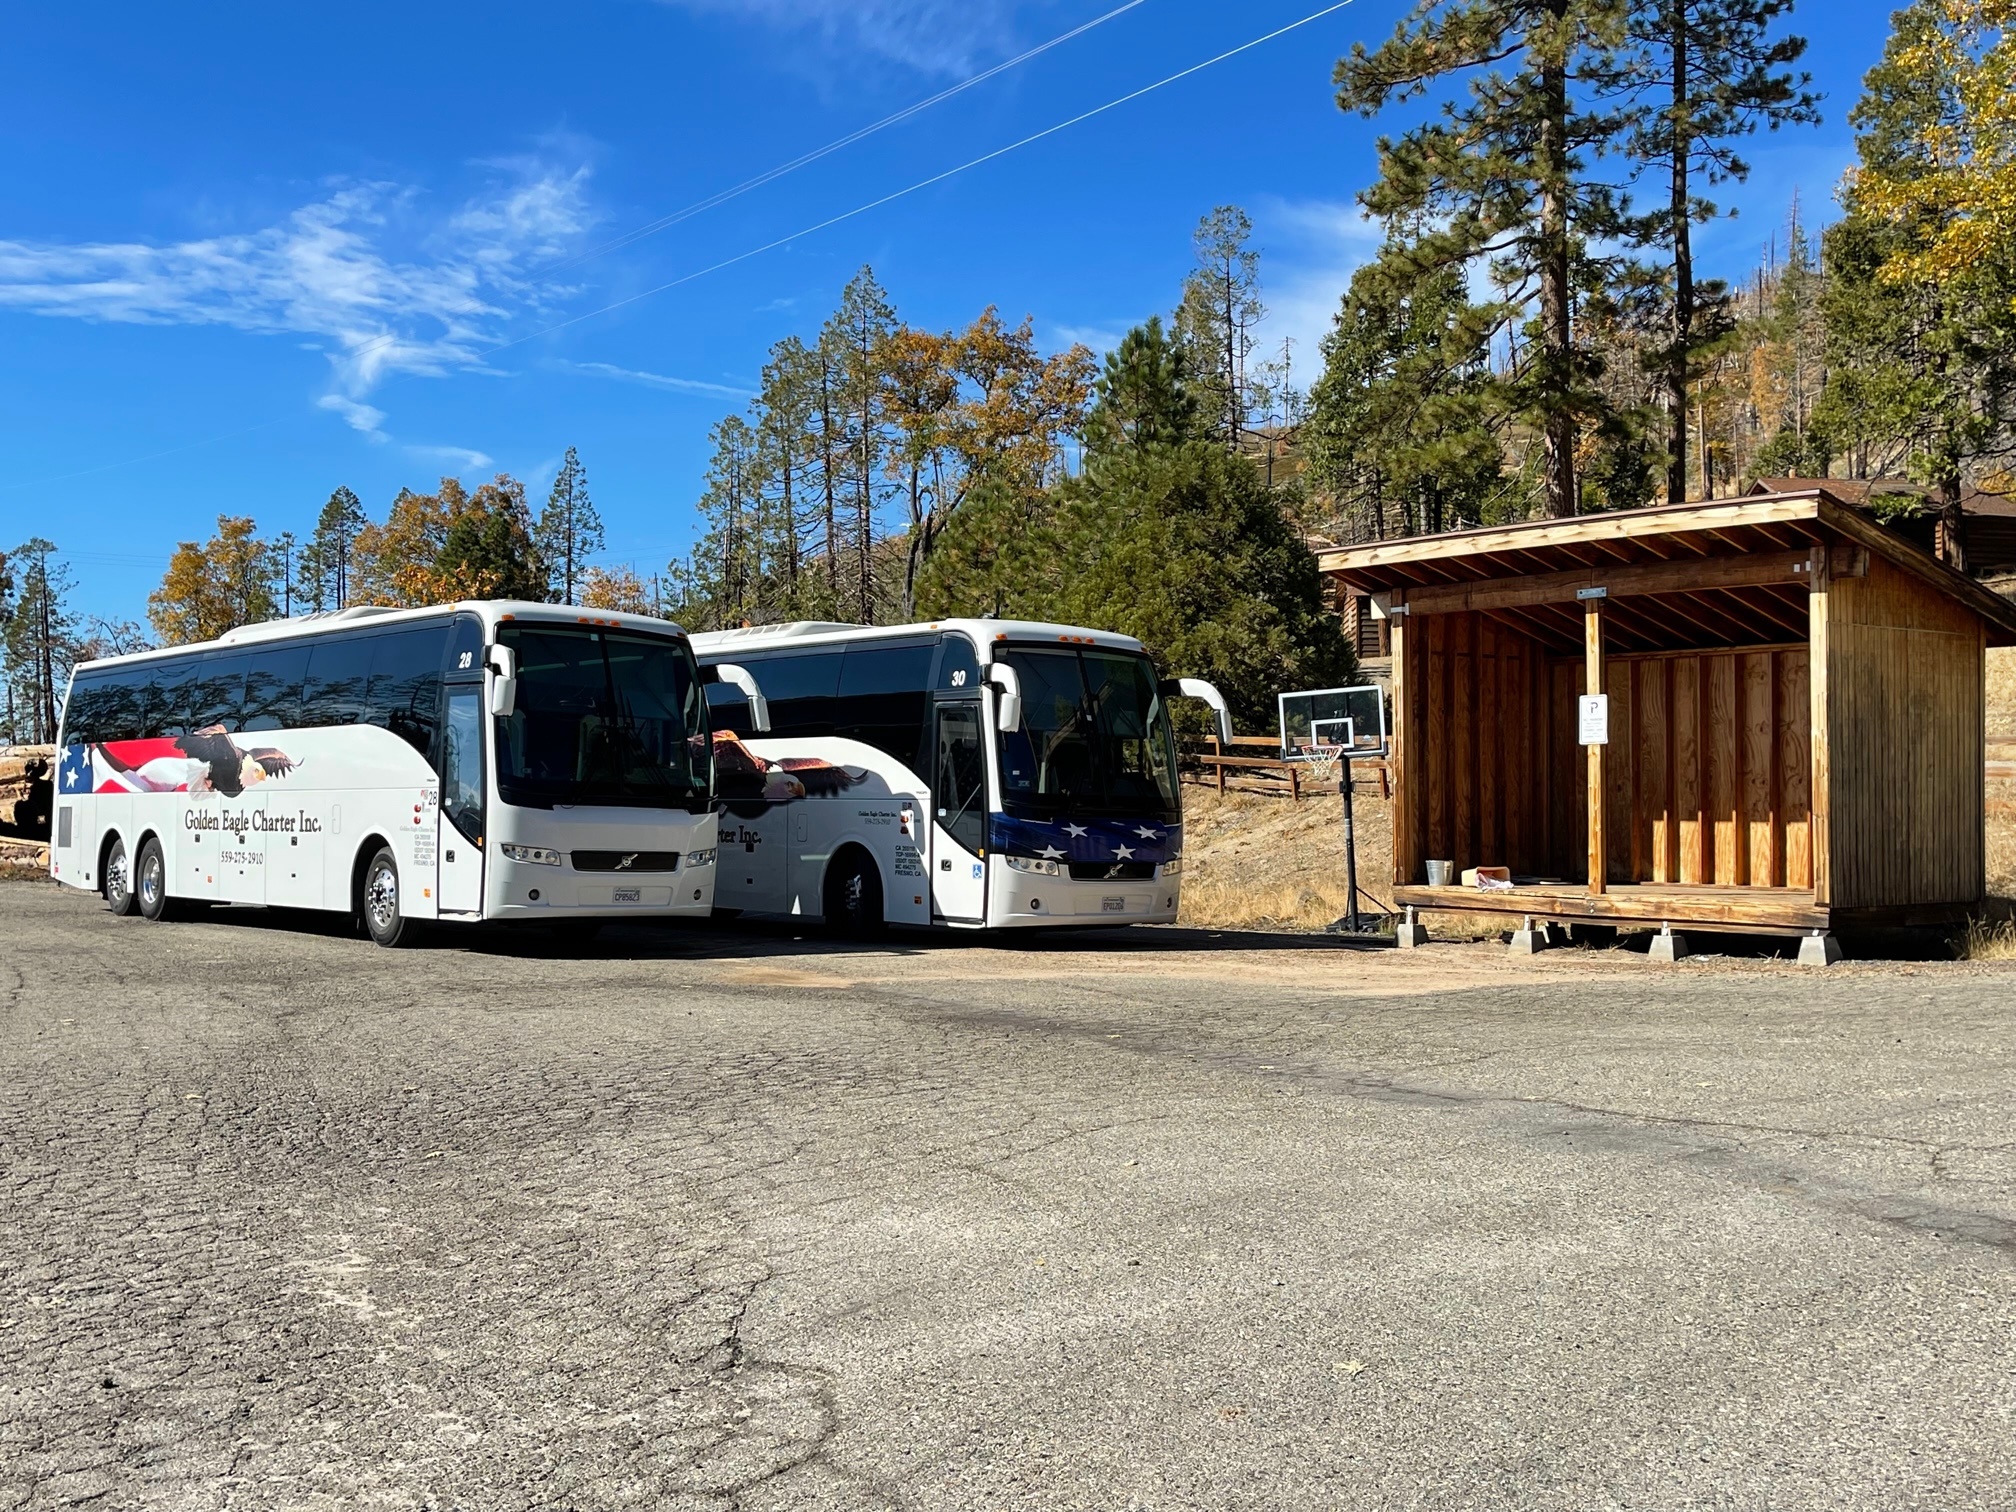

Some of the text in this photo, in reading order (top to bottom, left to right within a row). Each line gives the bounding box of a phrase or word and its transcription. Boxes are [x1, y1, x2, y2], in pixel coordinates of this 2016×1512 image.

[458, 651, 473, 669] 28
[951, 669, 966, 687] 30
[428, 791, 438, 805] 28
[184, 808, 322, 836] Golden Eagle Charter Inc.
[738, 824, 762, 844] Inc.
[221, 851, 264, 865] 559-275-2910
